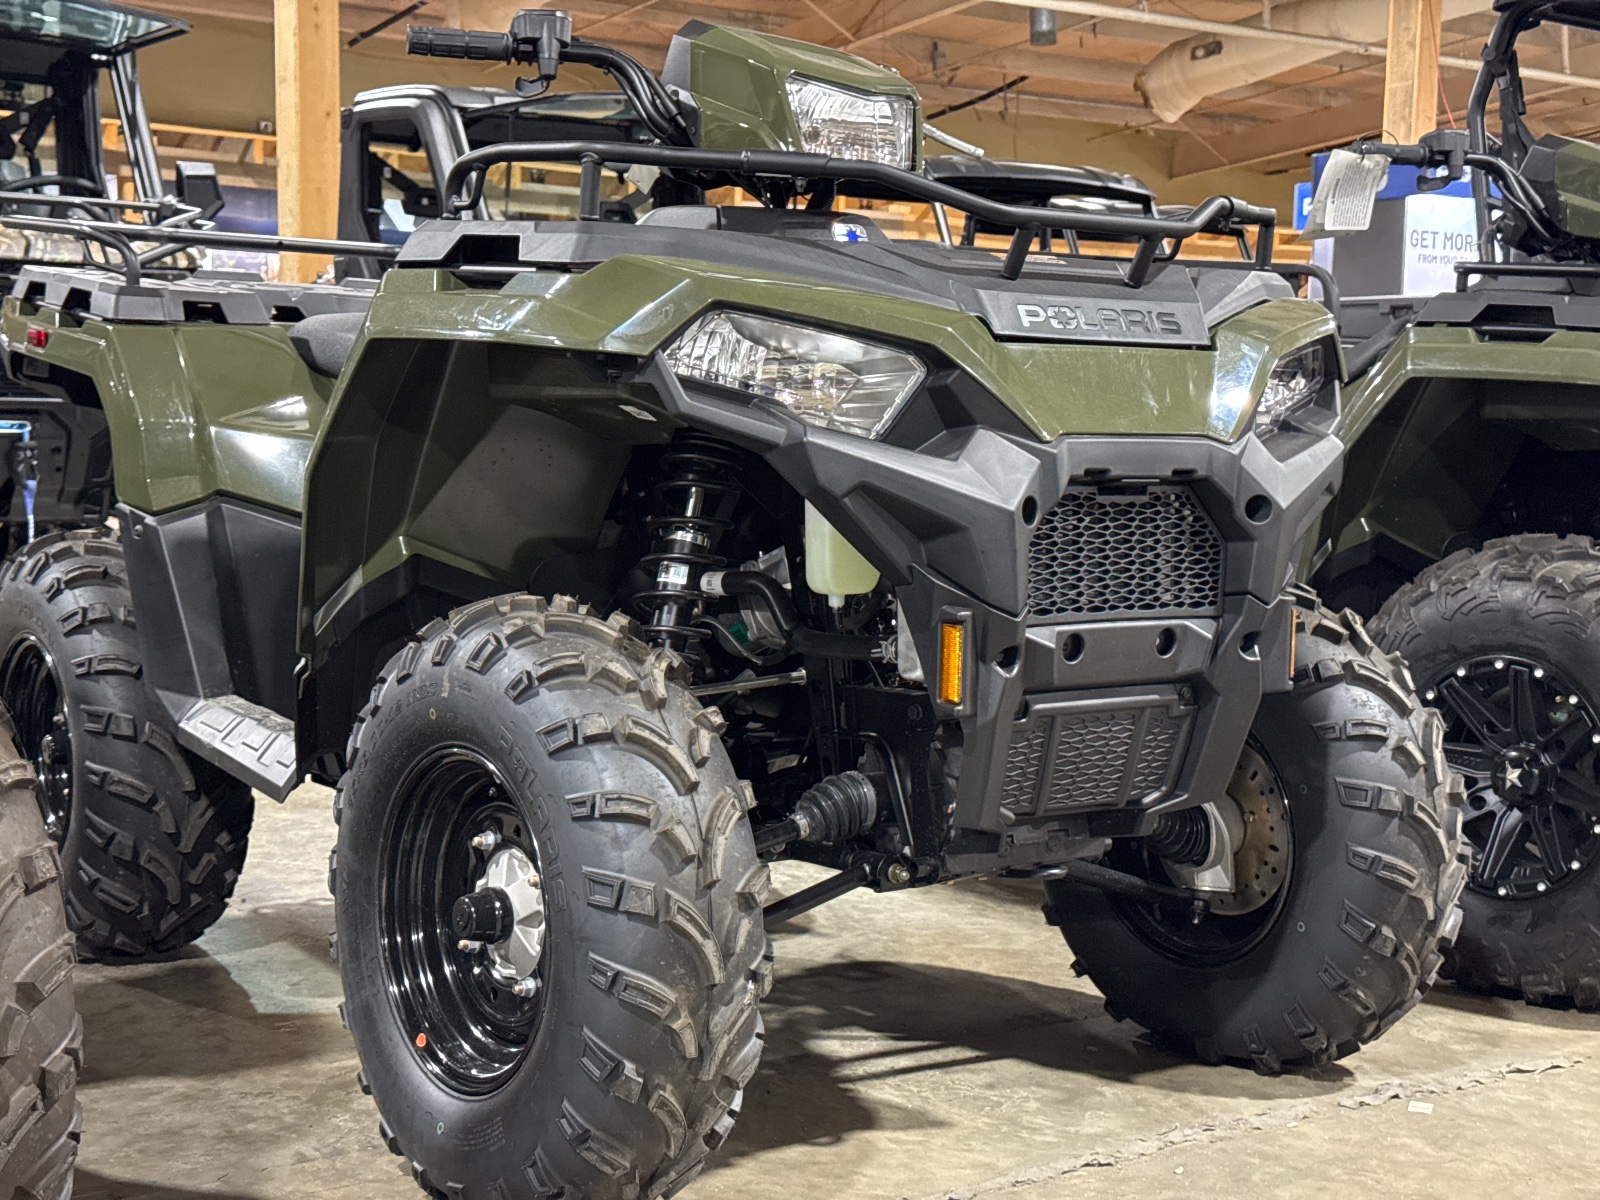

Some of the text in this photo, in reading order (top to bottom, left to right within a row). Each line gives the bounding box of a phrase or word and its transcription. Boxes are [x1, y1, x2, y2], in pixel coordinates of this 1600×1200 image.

[1410, 229, 1474, 253] GET MOR
[1417, 253, 1438, 264] FROM
[1016, 304, 1183, 335] POLARIS
